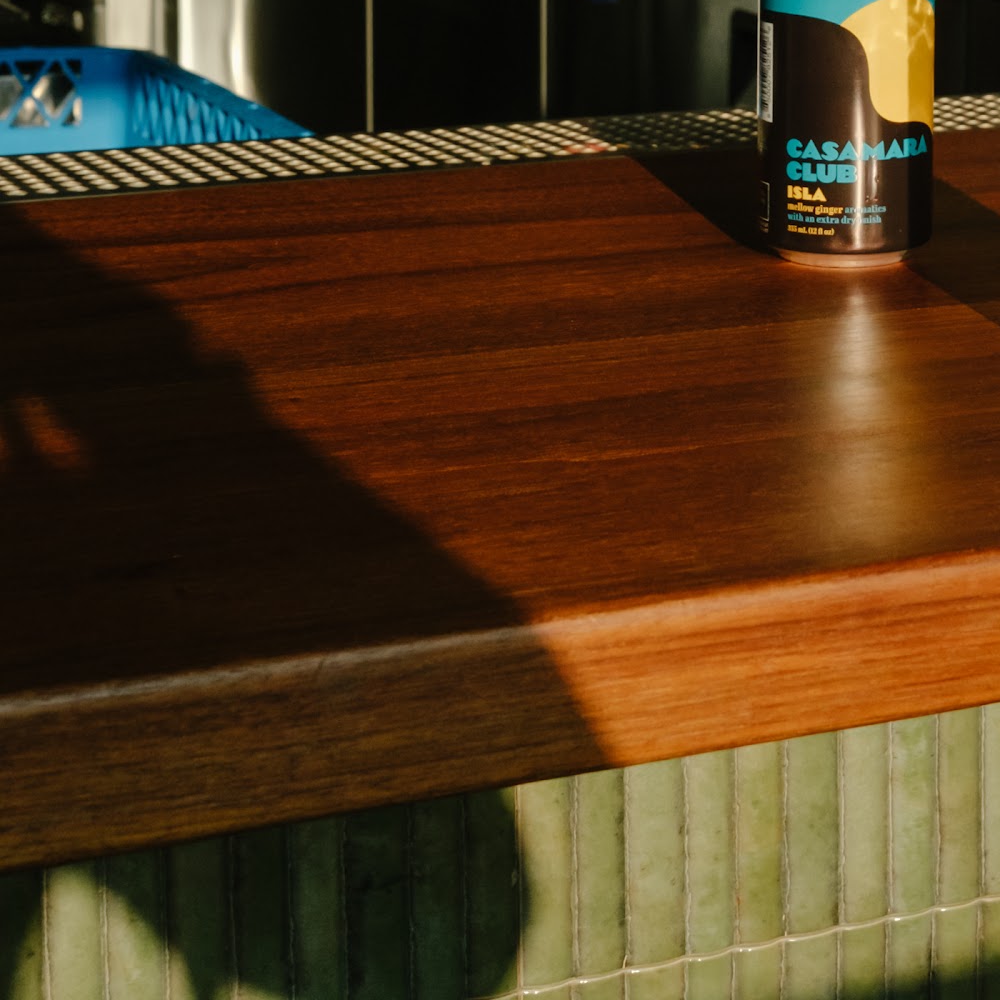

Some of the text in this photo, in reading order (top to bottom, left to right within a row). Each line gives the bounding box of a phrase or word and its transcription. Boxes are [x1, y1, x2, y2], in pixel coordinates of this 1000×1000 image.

[786, 134, 928, 161] CASAMARA
[786, 161, 857, 184] CLUB
[787, 185, 827, 202] ISLA
[787, 202, 814, 213] mellow
[814, 204, 844, 216] ginger
[787, 213, 804, 222] with
[816, 216, 840, 224] extra
[840, 214, 856, 226] dry
